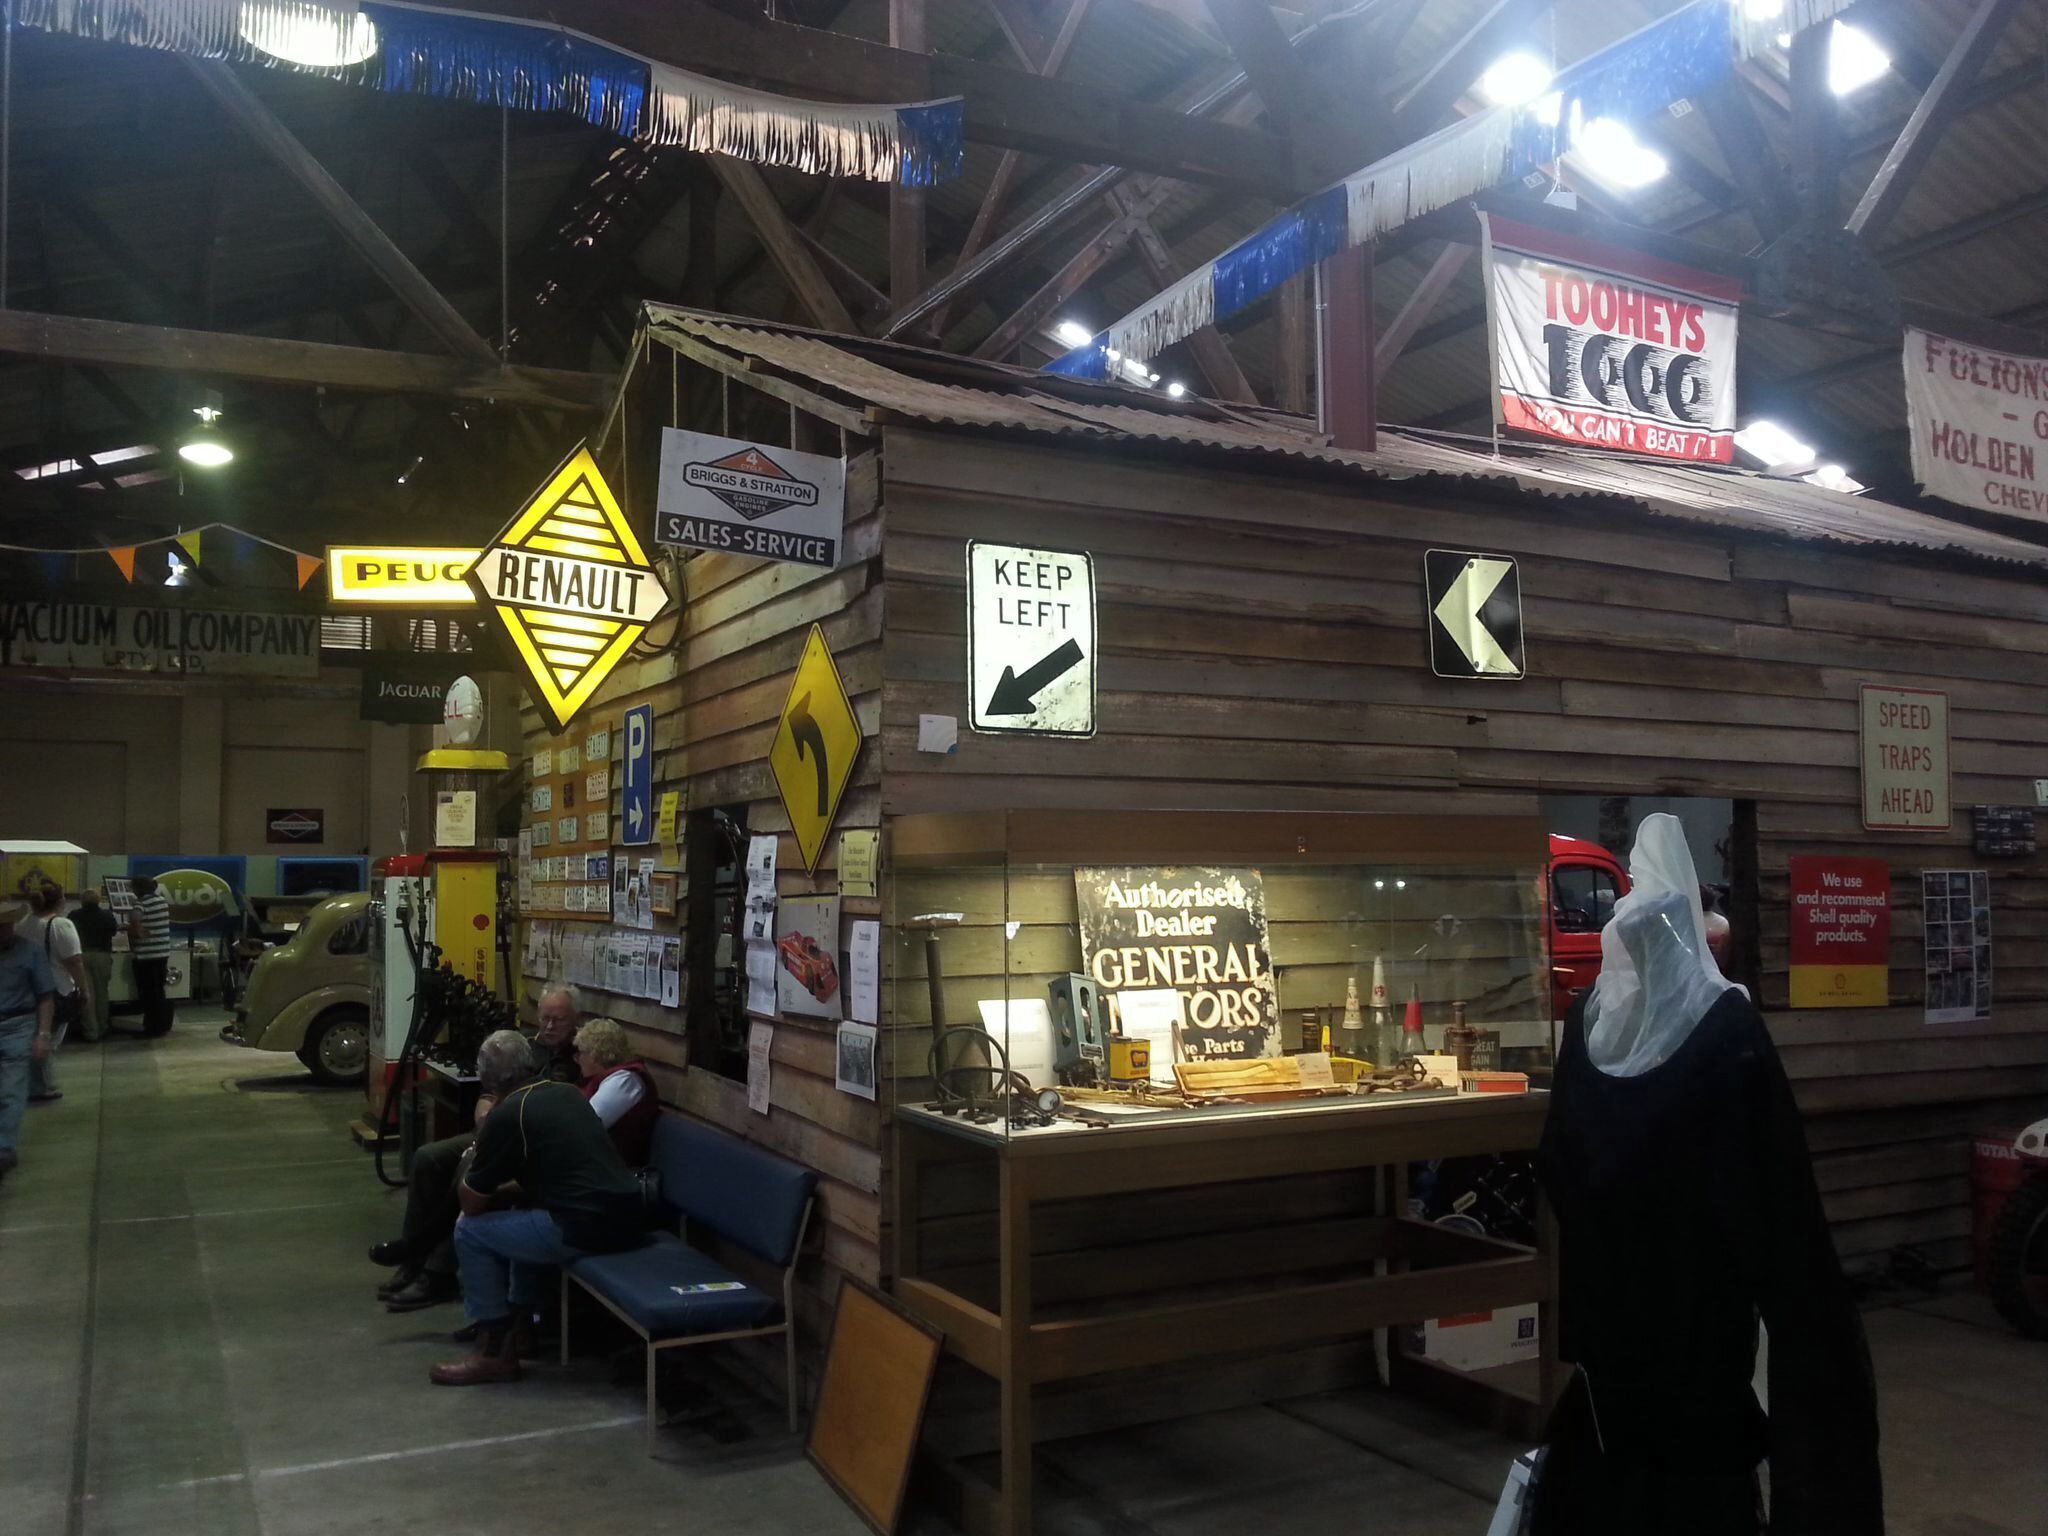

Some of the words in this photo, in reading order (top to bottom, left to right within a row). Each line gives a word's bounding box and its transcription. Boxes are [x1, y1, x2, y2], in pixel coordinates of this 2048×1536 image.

[1539, 270, 1706, 353] TOOHEYS
[1542, 322, 1713, 425] 1000
[1536, 406, 1575, 436] YOU
[1581, 416, 1637, 446] CAN'T
[1645, 429, 1689, 454] BEAT
[746, 452, 758, 466] 4
[1931, 419, 2034, 481] HOLDEN
[740, 463, 763, 472] CYCLE
[690, 468, 737, 487] BRIGGS
[739, 478, 748, 489] &
[750, 479, 811, 500] STRATTON
[1984, 481, 2048, 513] CHEV
[733, 494, 769, 506] GASOLINE
[735, 501, 767, 512] ENGINES
[497, 552, 645, 616] RENAULT
[994, 558, 1073, 591] KEEP
[998, 597, 1071, 630] LEFT
[133, 609, 177, 649] OIL
[378, 681, 442, 699] JAGUAR
[1879, 702, 1931, 730] SPEED
[628, 712, 645, 788] P
[1879, 743, 1932, 772] TRAPS
[1880, 787, 1934, 815] AHEAD
[1822, 872, 1841, 887] We
[1844, 876, 1863, 887] use
[1796, 889, 1819, 905] and
[1821, 891, 1886, 906] recommend
[1135, 908, 1217, 938] Dealer
[1809, 907, 1837, 923] Shell
[1839, 908, 1877, 929] quality
[1815, 926, 1867, 945] products.
[1092, 941, 1269, 989] GENERAL
[1100, 988, 1263, 1034] TORS
[1203, 1037, 1245, 1055] Parts
[1473, 1040, 1495, 1053] REAT
[1975, 1142, 2020, 1161] TOTAL
